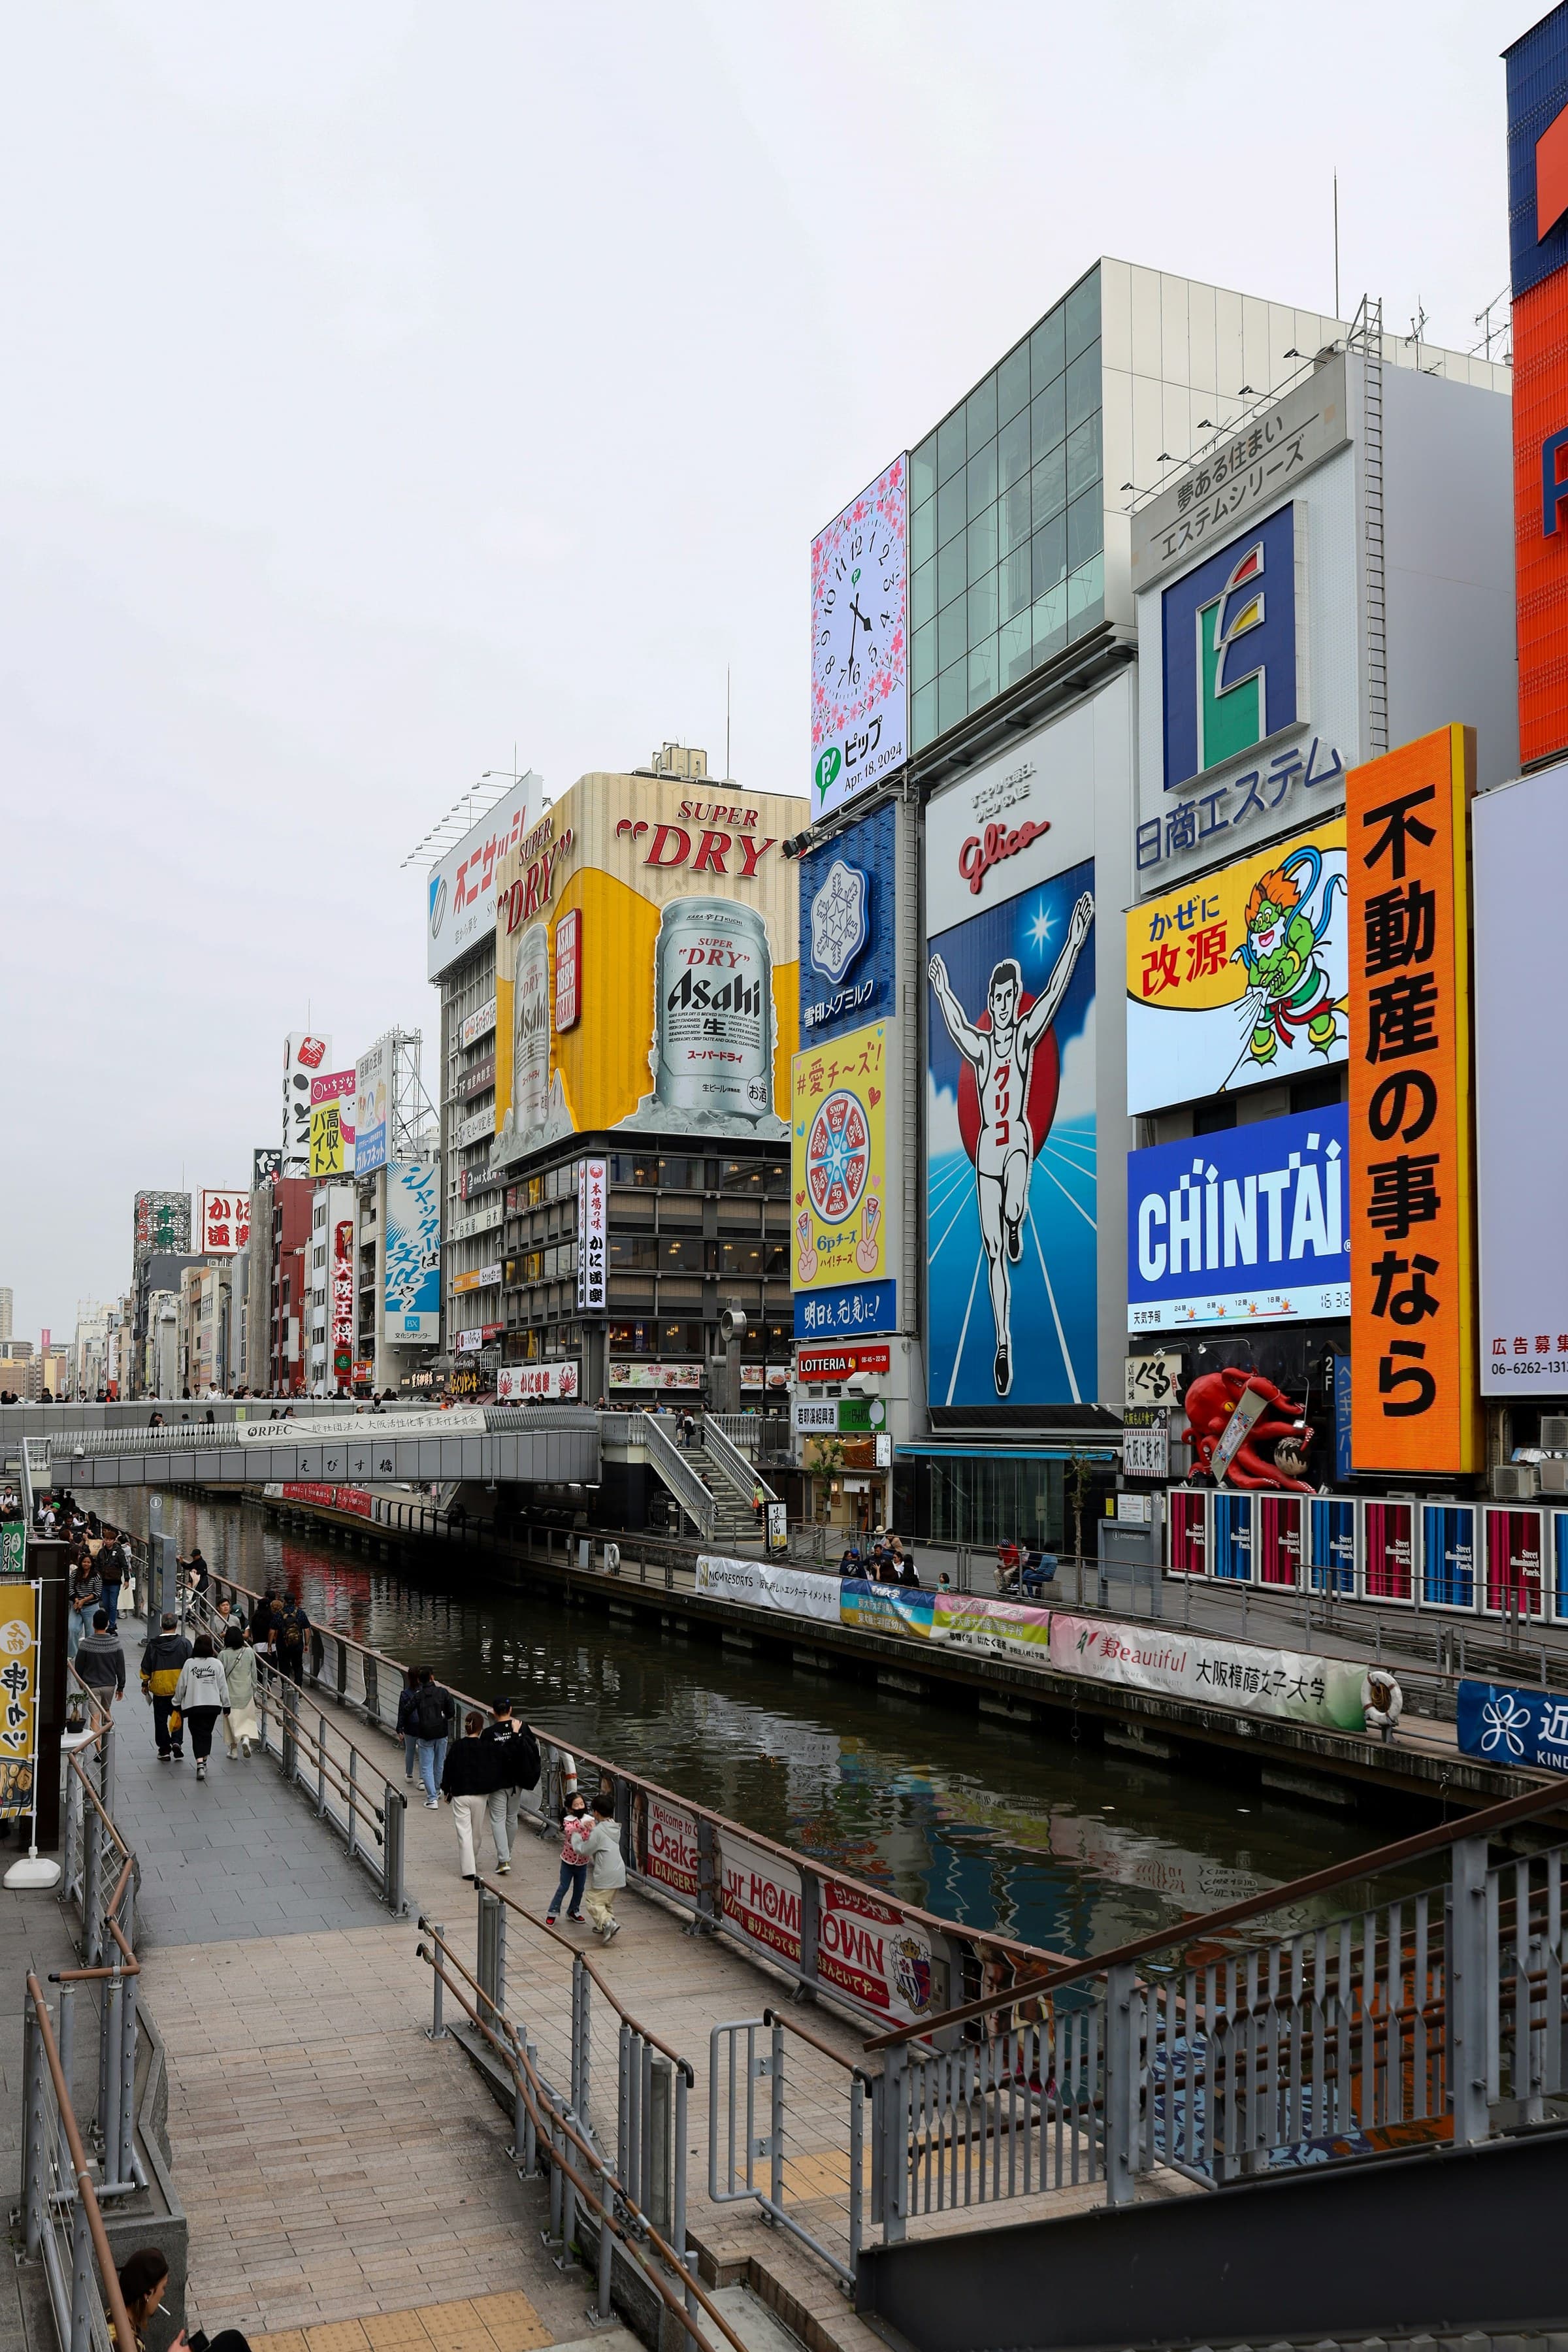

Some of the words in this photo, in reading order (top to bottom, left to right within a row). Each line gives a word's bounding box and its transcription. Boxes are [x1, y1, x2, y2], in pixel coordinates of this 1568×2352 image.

[1177, 416, 1282, 514] 夢ある住まい
[1162, 433, 1305, 561] エステムシリーズ
[850, 536, 862, 561] 12
[878, 544, 890, 566] 2
[883, 572, 896, 593] 3
[879, 610, 890, 629] 4
[821, 630, 831, 646] 9
[868, 642, 877, 664] 5
[825, 655, 836, 675] 8
[837, 668, 847, 689] 7
[853, 663, 861, 685] 6
[845, 715, 883, 768] ピップ
[845, 772, 862, 792] Apr.
[864, 760, 876, 778] 18,
[878, 742, 903, 768] 2024
[678, 800, 759, 828] SUPER
[1135, 736, 1346, 872] 日商エステム
[519, 817, 553, 866] SUPER
[958, 821, 1051, 894] Glico
[1149, 894, 1220, 942] かぜに
[557, 919, 576, 958] ASAHI
[698, 938, 733, 949] SUPER
[1141, 919, 1228, 998] 改源
[557, 959, 576, 994] 1889
[667, 968, 760, 1018] Asahi
[804, 979, 874, 1028] 雪印メグミルク
[517, 991, 546, 1042] Asahi
[556, 992, 576, 1026] OSAKA
[704, 1018, 727, 1036] 生
[687, 1050, 743, 1063] スーパードライ
[459, 1079, 466, 1098] 7F
[749, 1085, 767, 1103] お酒
[992, 1057, 1012, 1147] グリコ
[1363, 783, 1441, 1417] 不動産の事なら
[829, 1102, 845, 1115] SNOW
[314, 1111, 325, 1173] バイト
[326, 1109, 339, 1171] 高収入
[590, 1182, 602, 1231] 本場の味
[828, 1201, 844, 1213] SNOW
[1138, 1133, 1342, 1282] CHINTAI
[589, 1235, 603, 1303] かに道楽
[332, 1257, 353, 1345] 大阪王将
[407, 1319, 418, 1328] BX
[1134, 1310, 1161, 1325] 天気予報
[1492, 1334, 1568, 1356] 広告募集
[800, 1358, 846, 1372] LOTTERIA
[1135, 1362, 1171, 1399] くくる
[1492, 1361, 1568, 1375] 06-6262-131
[520, 1371, 549, 1394] かに道楽
[300, 1459, 393, 1473] えびす橋
[1456, 1544, 1471, 1554] Street
[1522, 1549, 1538, 1559] Street
[1195, 1658, 1326, 1707] 大阪樟蔭女子大学
[652, 1803, 683, 1831] Welcome
[685, 1821, 692, 1834] to
[652, 1823, 698, 1870] Osaka
